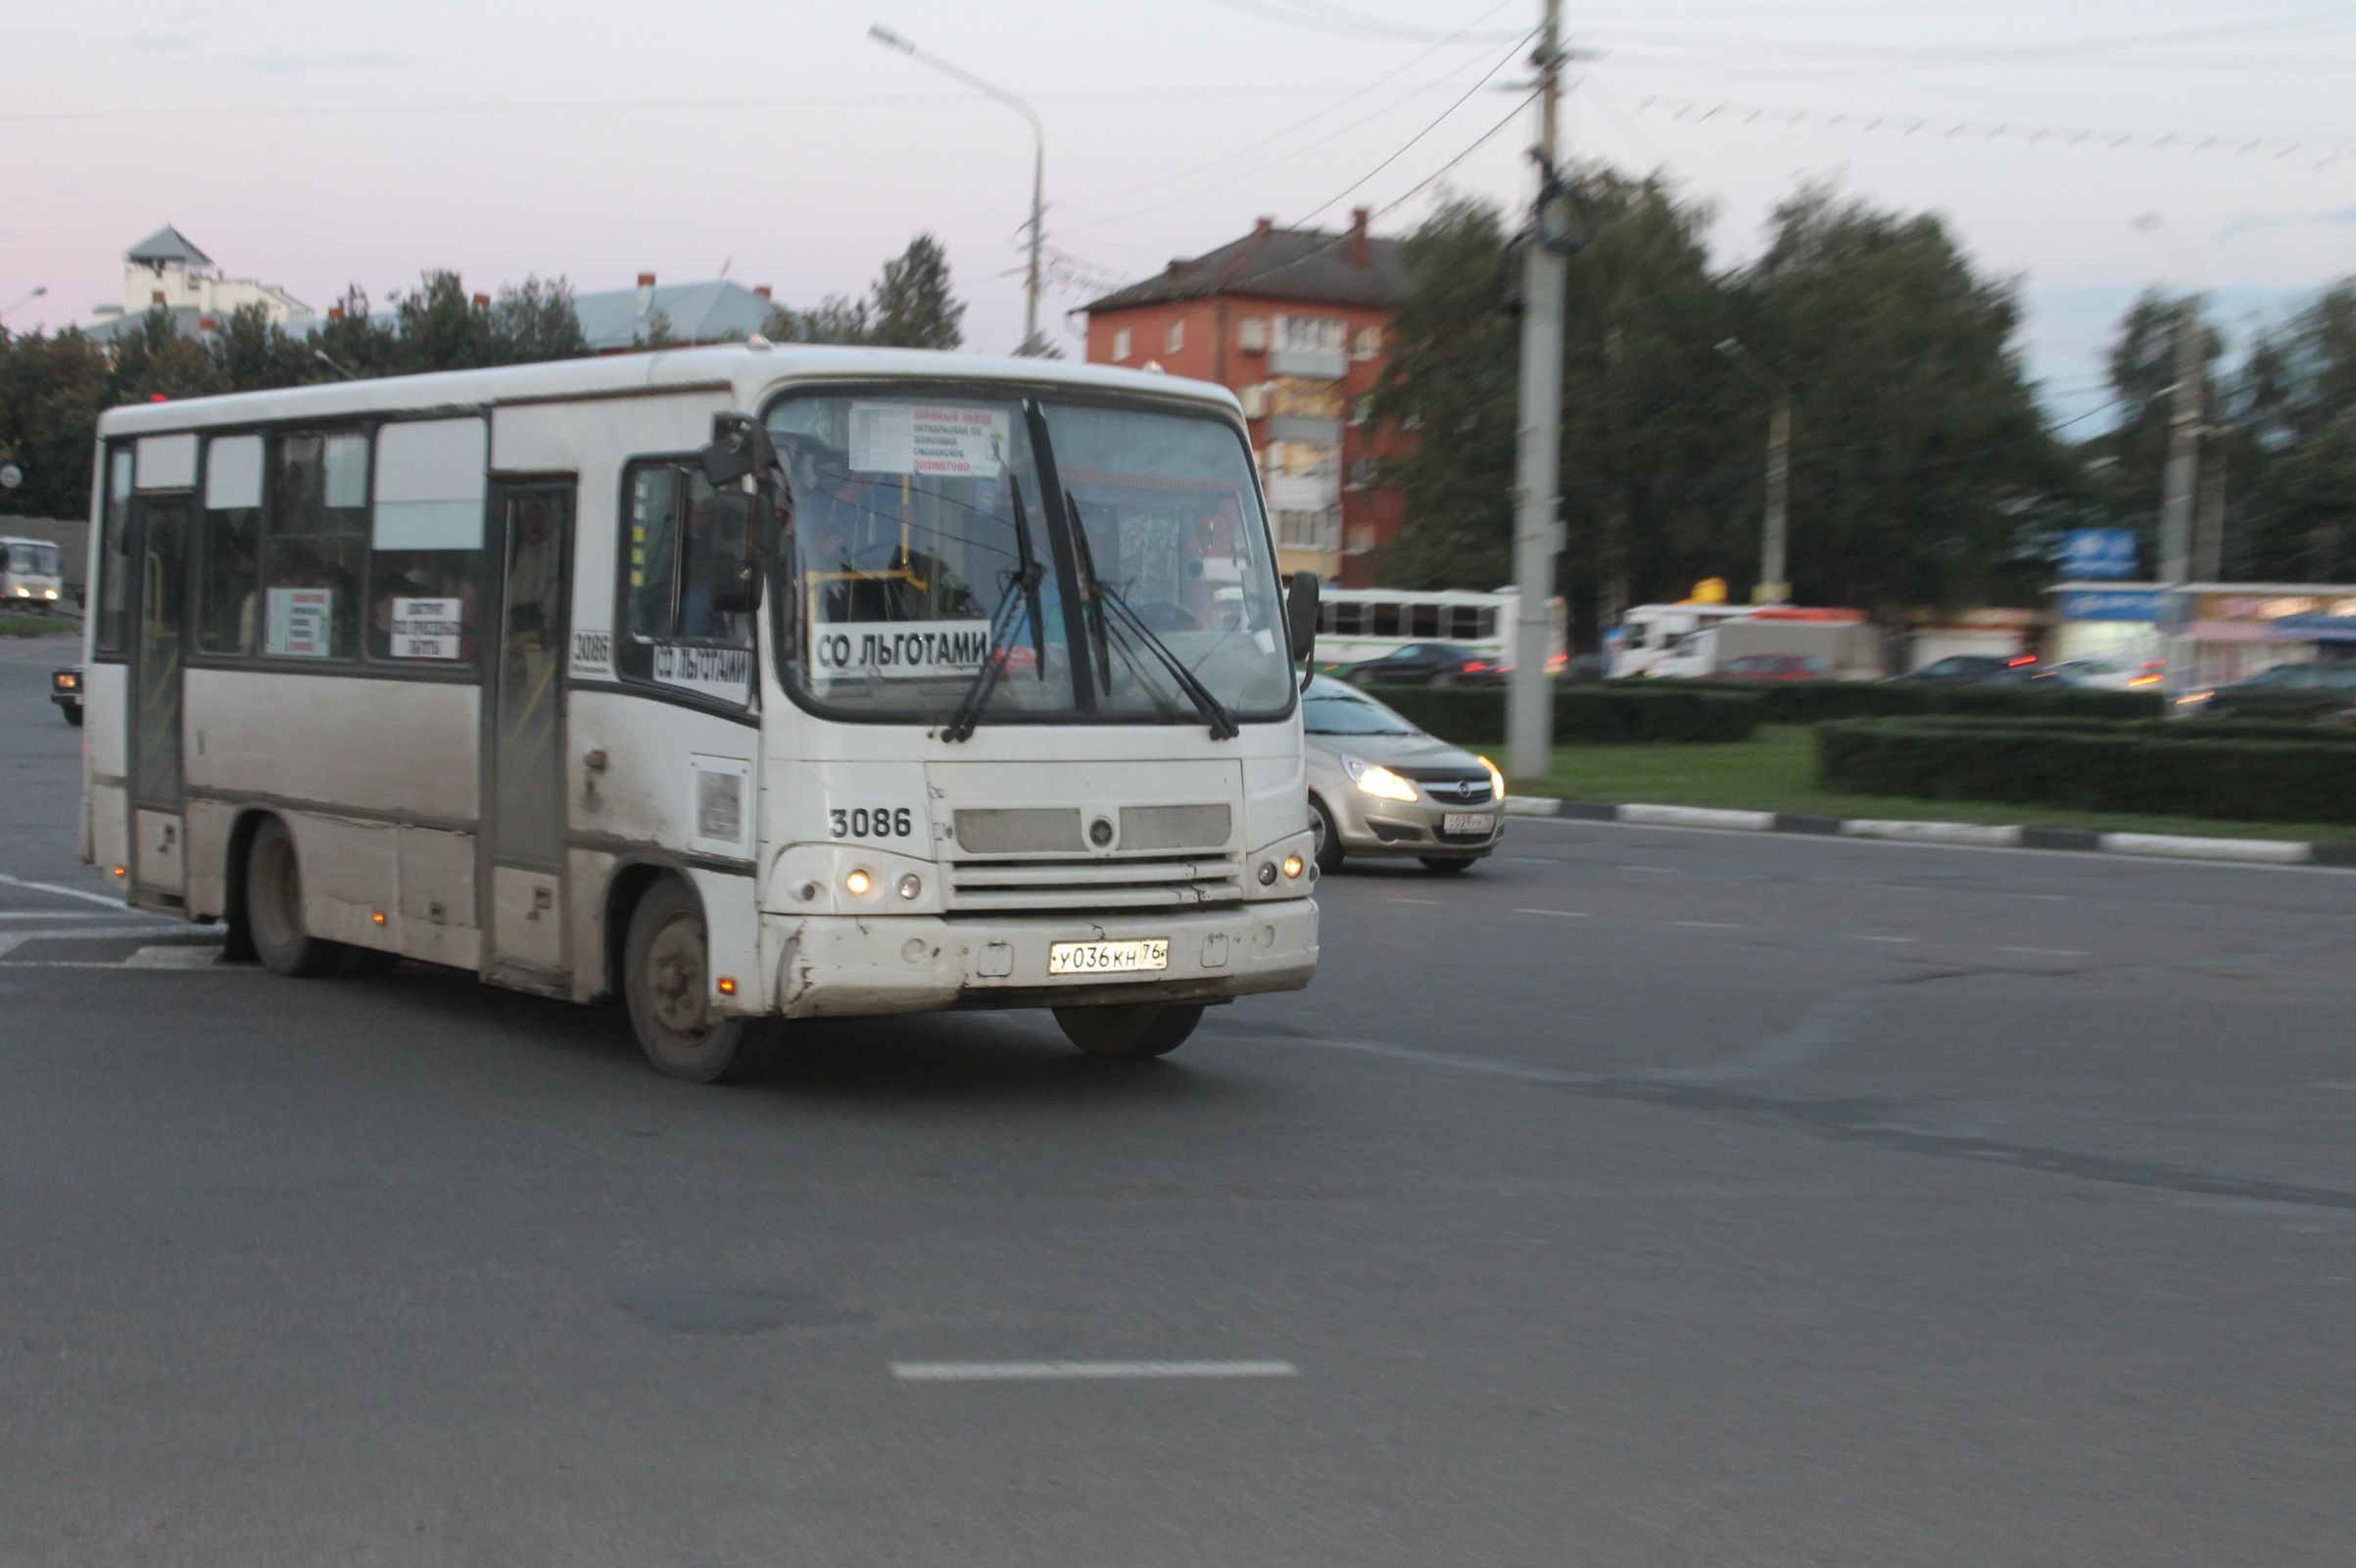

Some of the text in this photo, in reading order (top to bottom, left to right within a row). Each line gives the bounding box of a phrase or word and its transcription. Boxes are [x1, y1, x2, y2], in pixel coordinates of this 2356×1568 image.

[573, 633, 613, 663] 3086
[655, 645, 676, 678] СО
[817, 633, 850, 667] СО
[858, 631, 987, 666] ЛЬГОТАМИ
[829, 807, 911, 838] 3086
